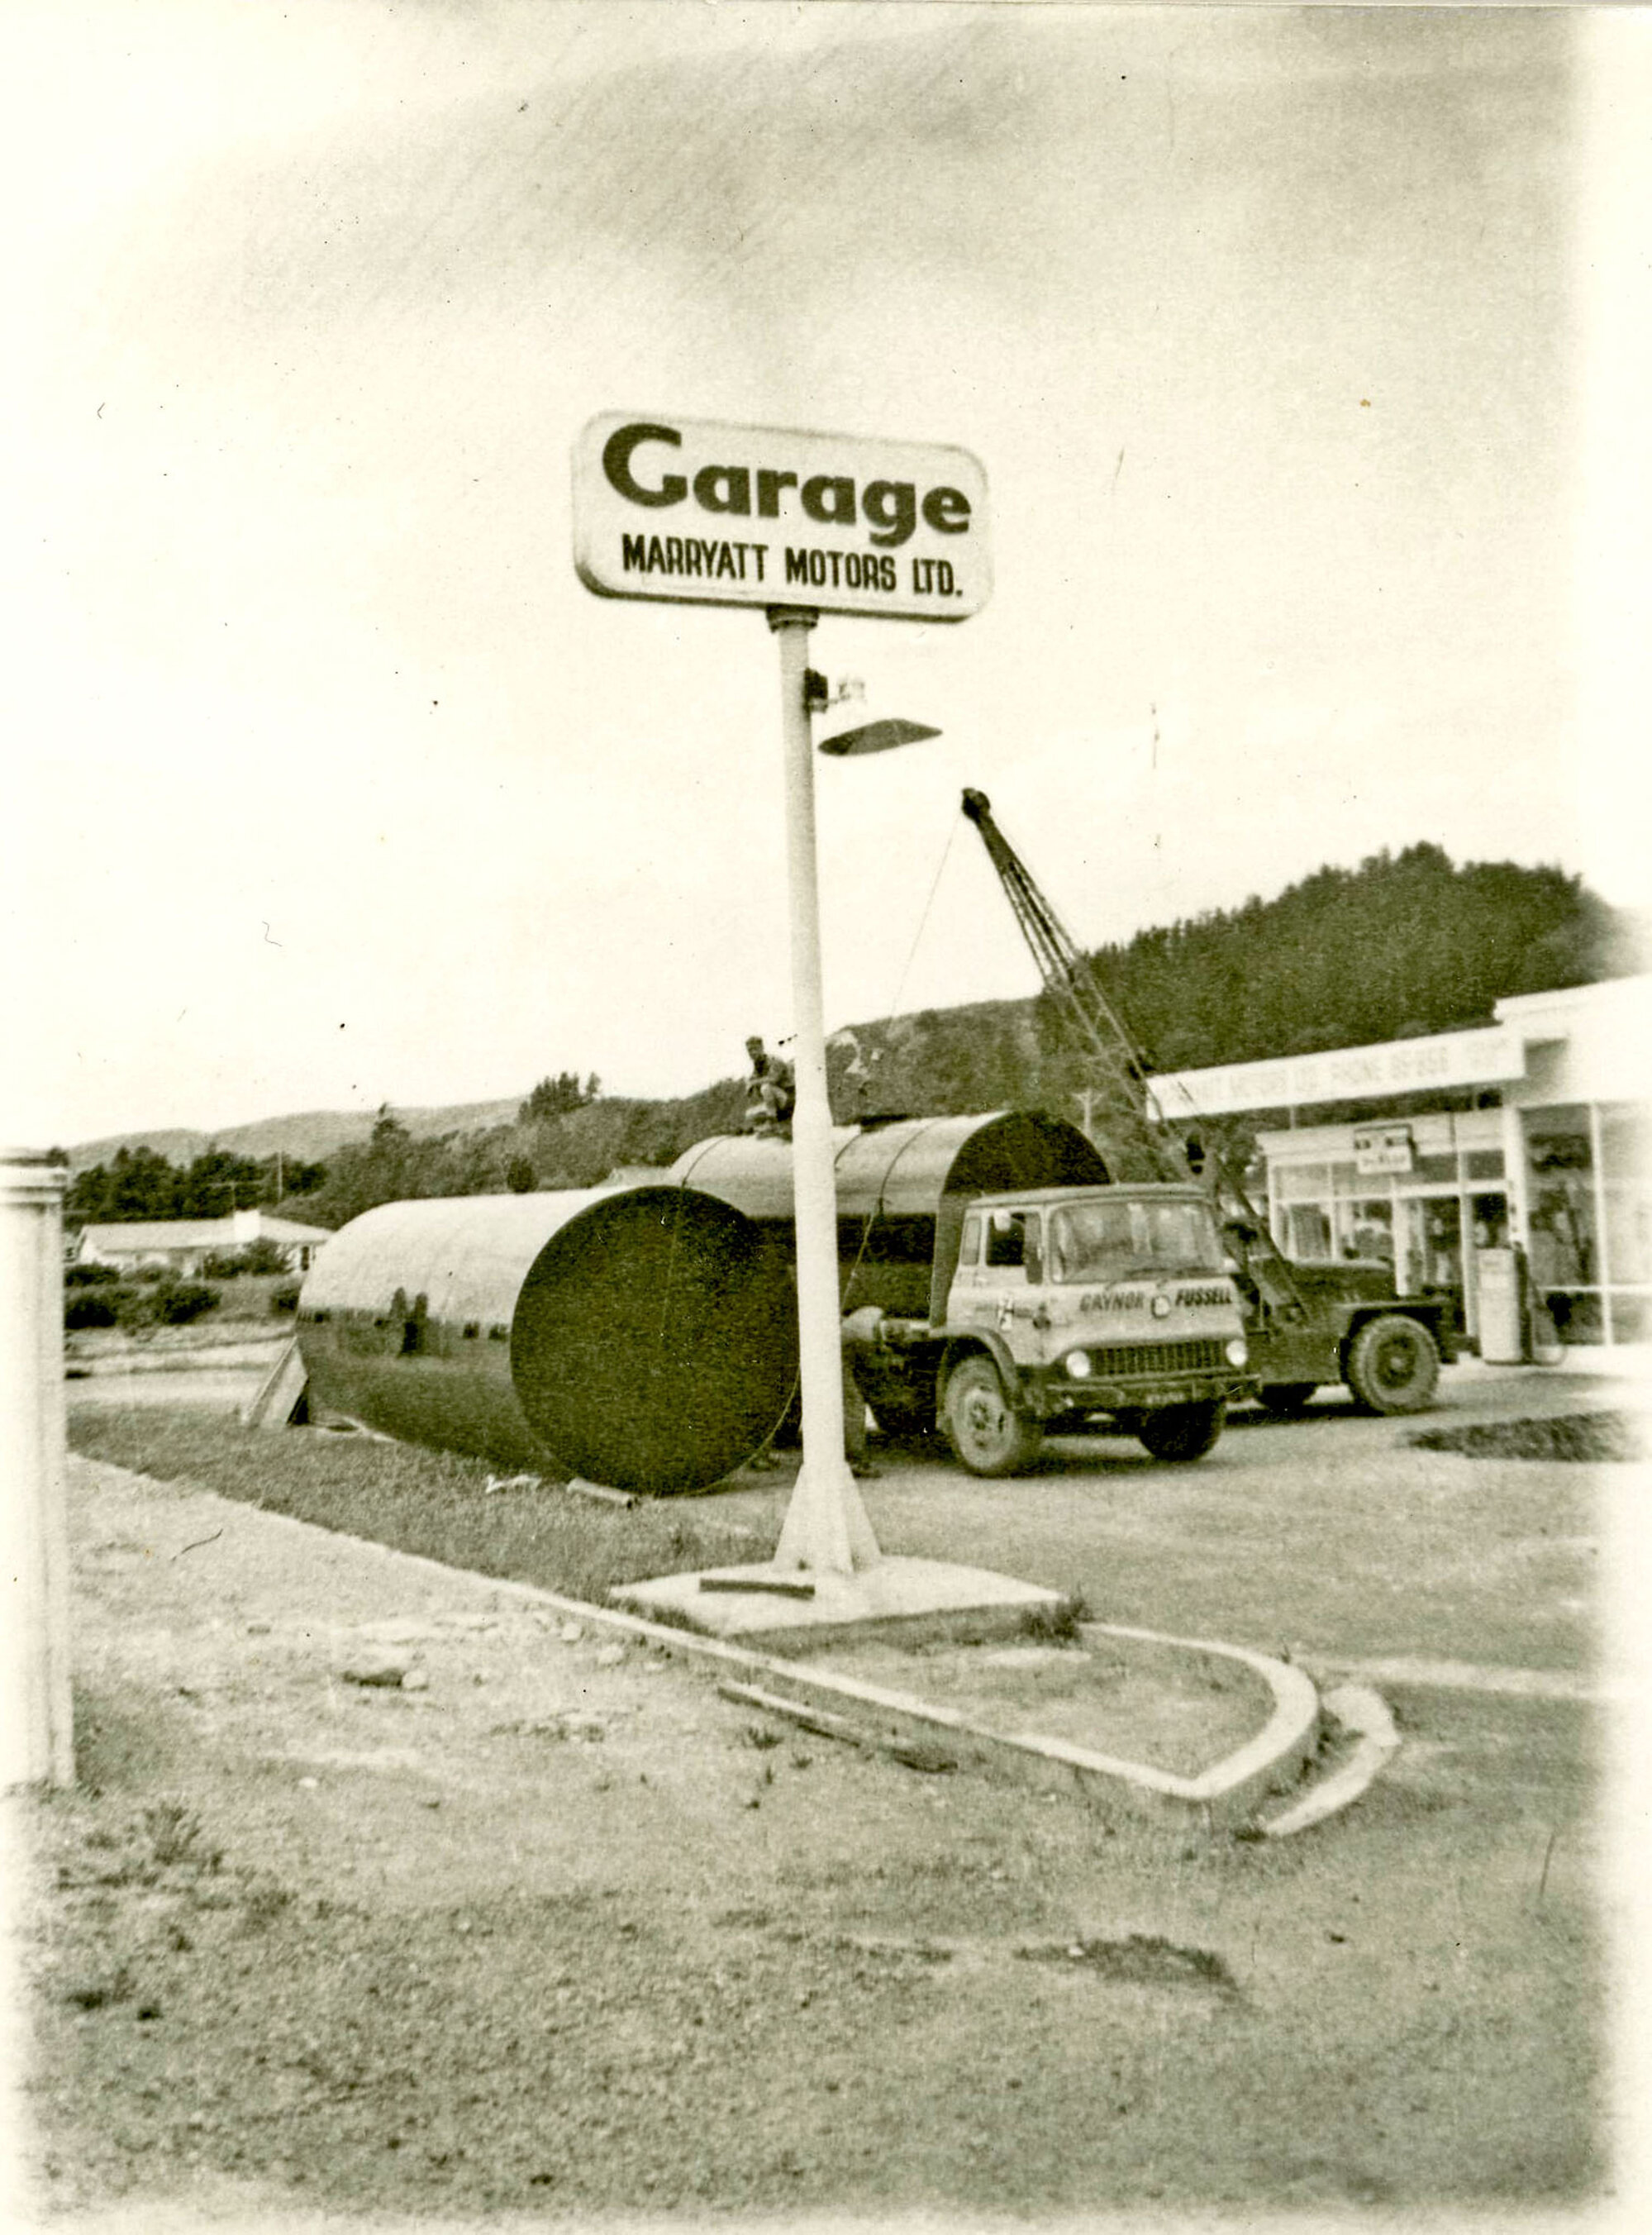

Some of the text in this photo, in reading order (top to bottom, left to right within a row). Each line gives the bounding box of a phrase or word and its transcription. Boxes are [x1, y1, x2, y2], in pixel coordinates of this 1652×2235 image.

[602, 422, 972, 548] Garage
[622, 533, 964, 597] MARRYATT MOTORS LTD.
[1174, 1286, 1232, 1308] FUSSELL
